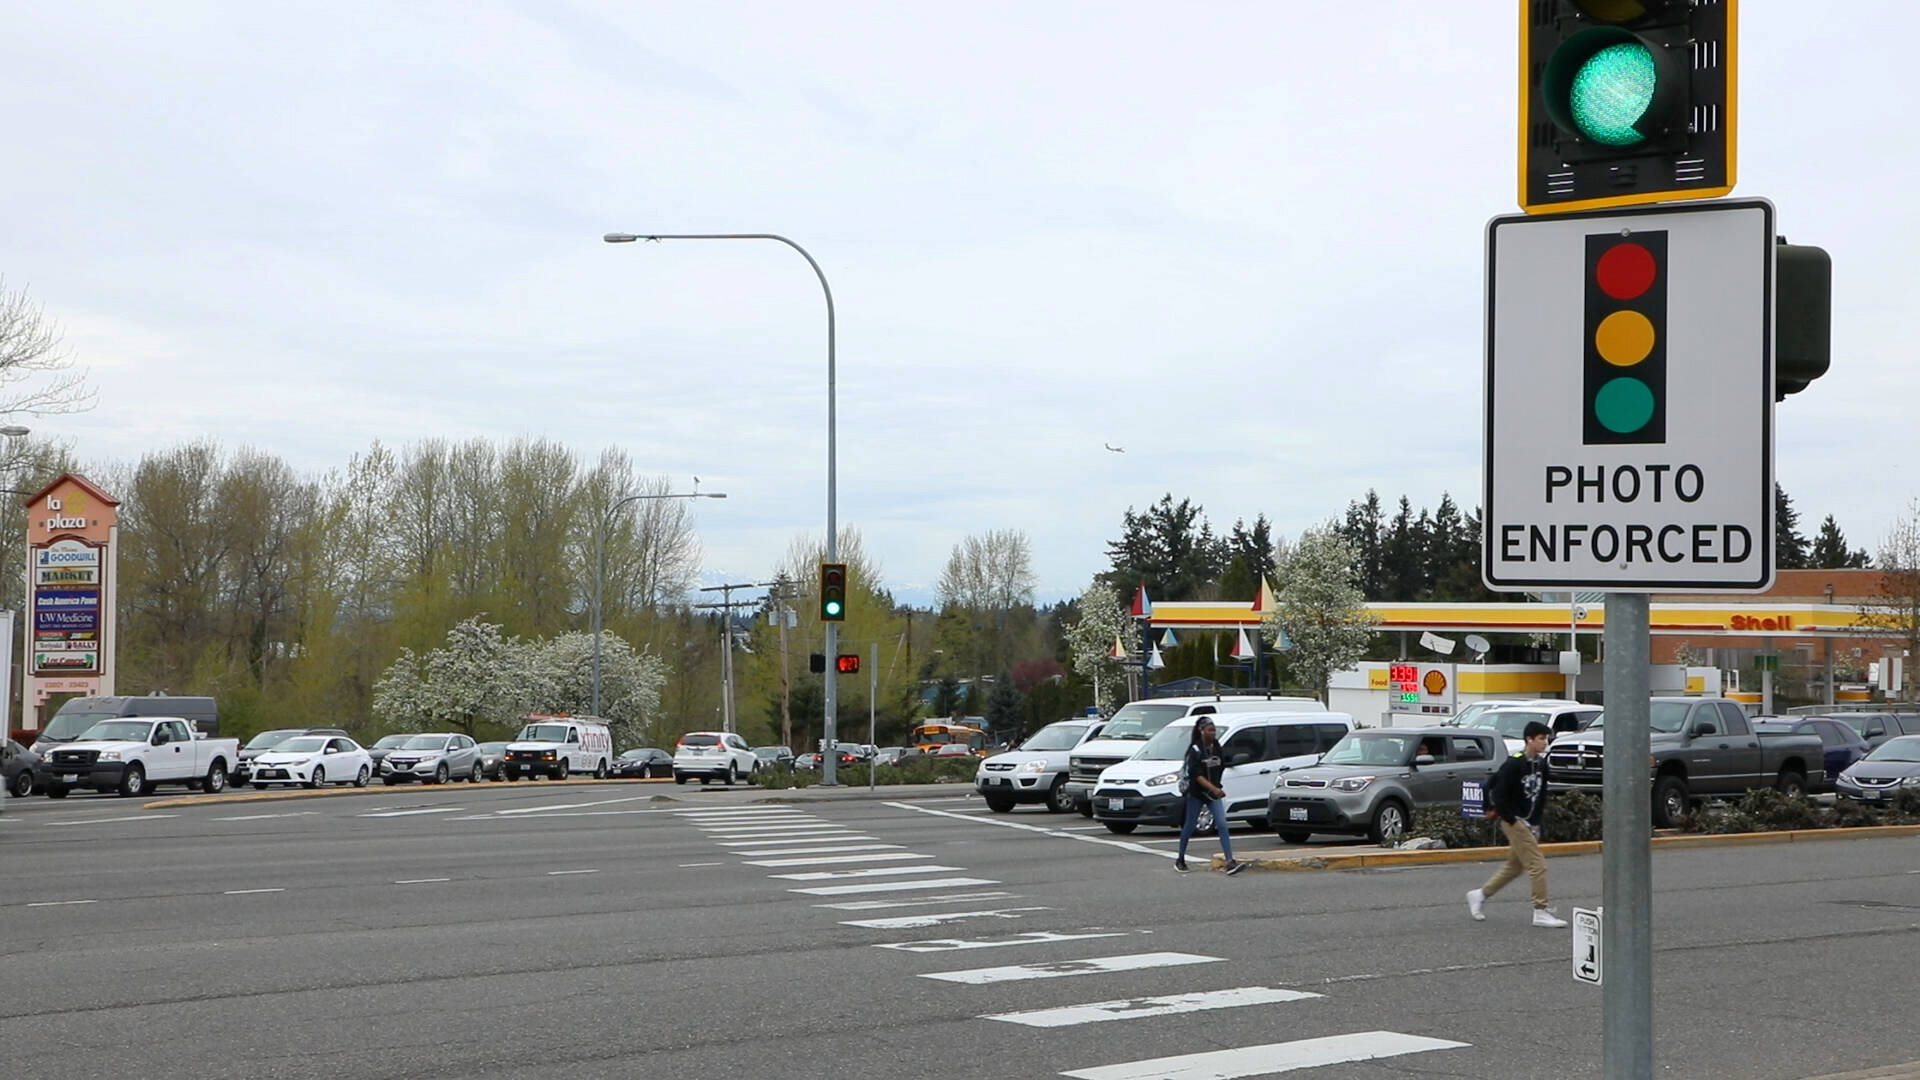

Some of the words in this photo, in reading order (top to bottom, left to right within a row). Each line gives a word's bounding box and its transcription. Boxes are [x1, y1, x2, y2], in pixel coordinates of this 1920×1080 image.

[1546, 464, 1704, 503] PHOTO
[47, 495, 61, 510] la
[47, 513, 86, 532] plaza
[1501, 524, 1752, 563] ENFORCED
[51, 553, 96, 561] GOODWILL
[41, 571, 93, 582] MARKET
[57, 613, 94, 622] Medicine
[1731, 615, 1792, 631] Shell
[579, 727, 609, 752] xfinity
